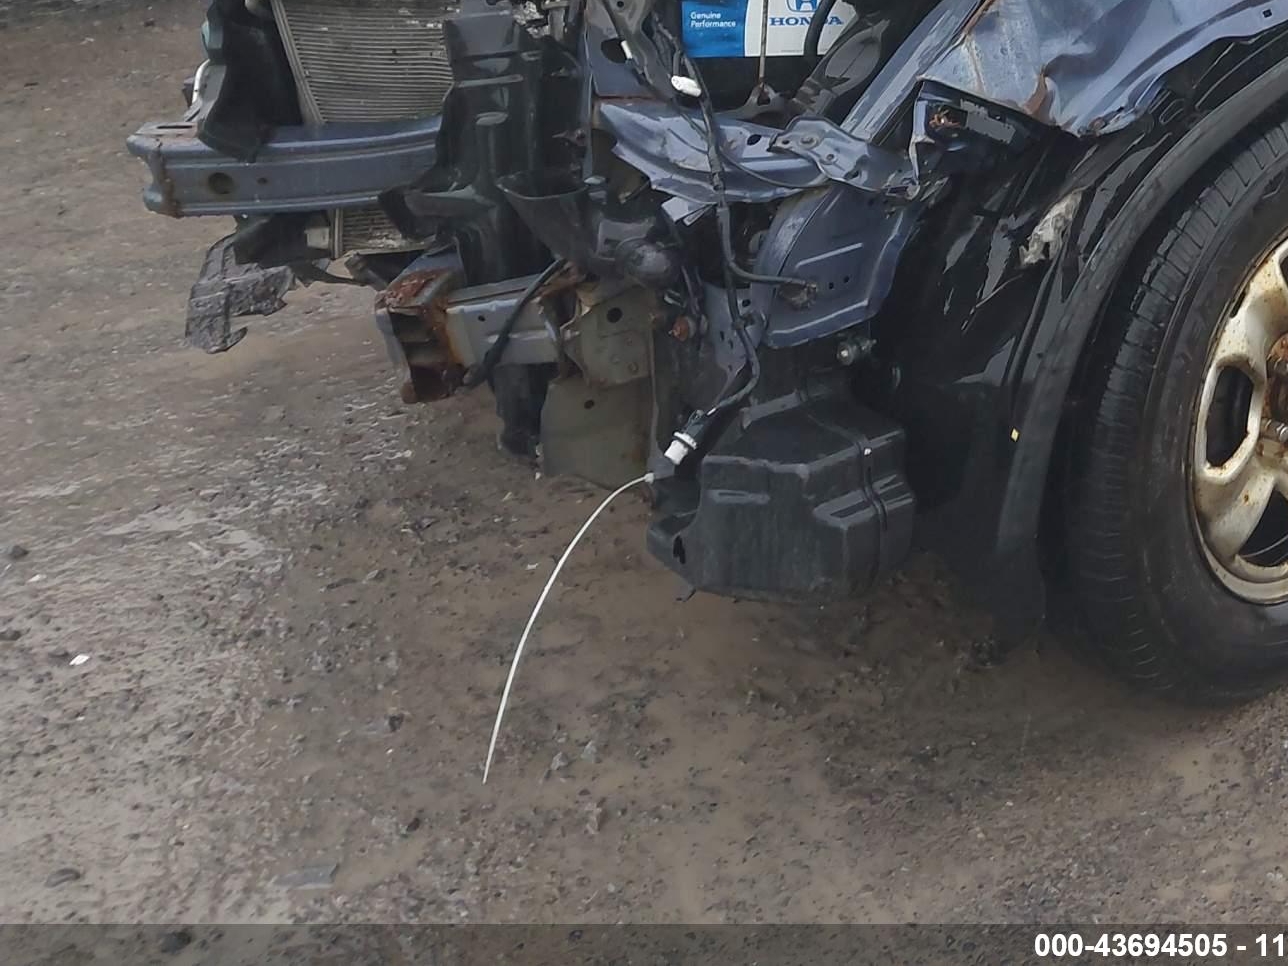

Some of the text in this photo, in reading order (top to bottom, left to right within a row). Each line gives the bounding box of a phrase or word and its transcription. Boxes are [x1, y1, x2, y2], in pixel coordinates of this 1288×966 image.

[690, 11, 722, 20] Genuine
[690, 20, 737, 29] Performance
[769, 15, 845, 27] HONA
